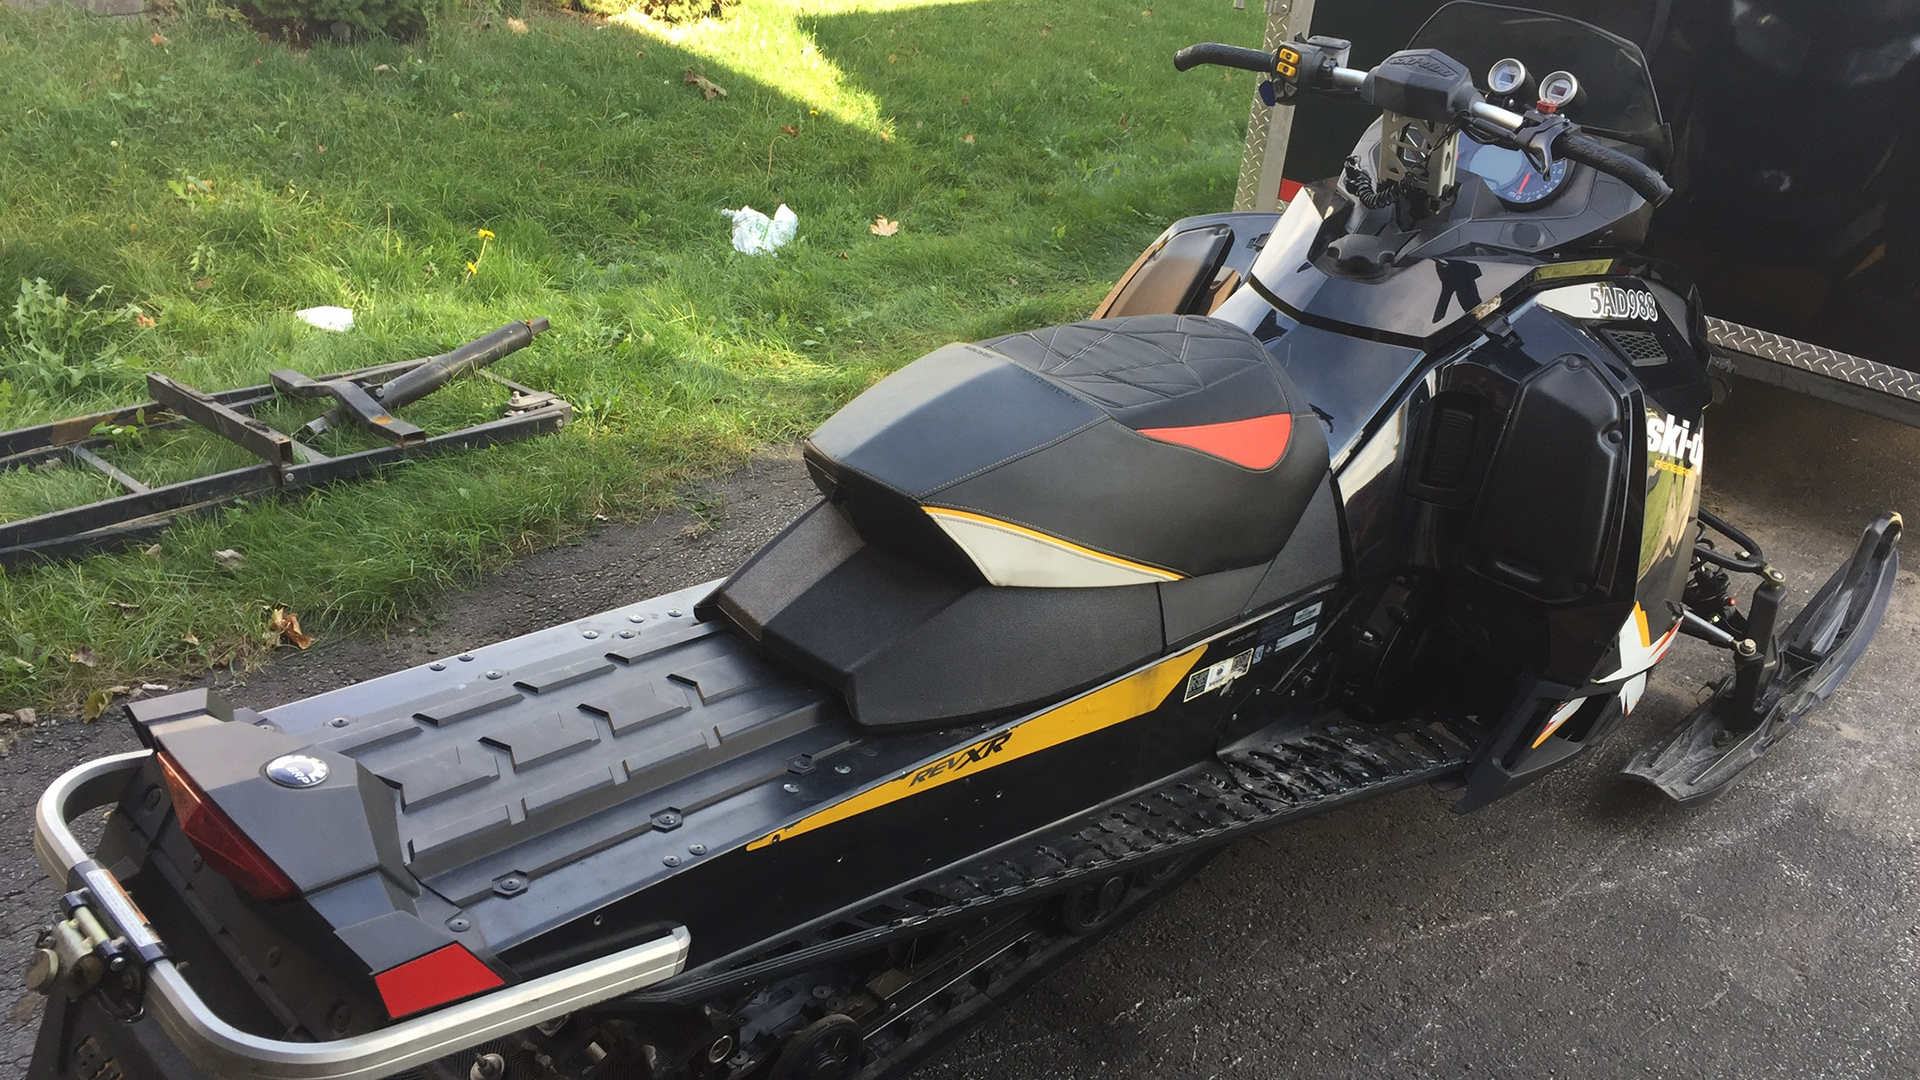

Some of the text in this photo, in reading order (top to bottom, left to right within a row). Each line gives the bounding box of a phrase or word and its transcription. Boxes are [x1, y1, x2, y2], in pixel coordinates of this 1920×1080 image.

[1588, 285, 1659, 322] 5AD988
[1654, 459, 1695, 478] RENEGA
[286, 766, 311, 784] BRP
